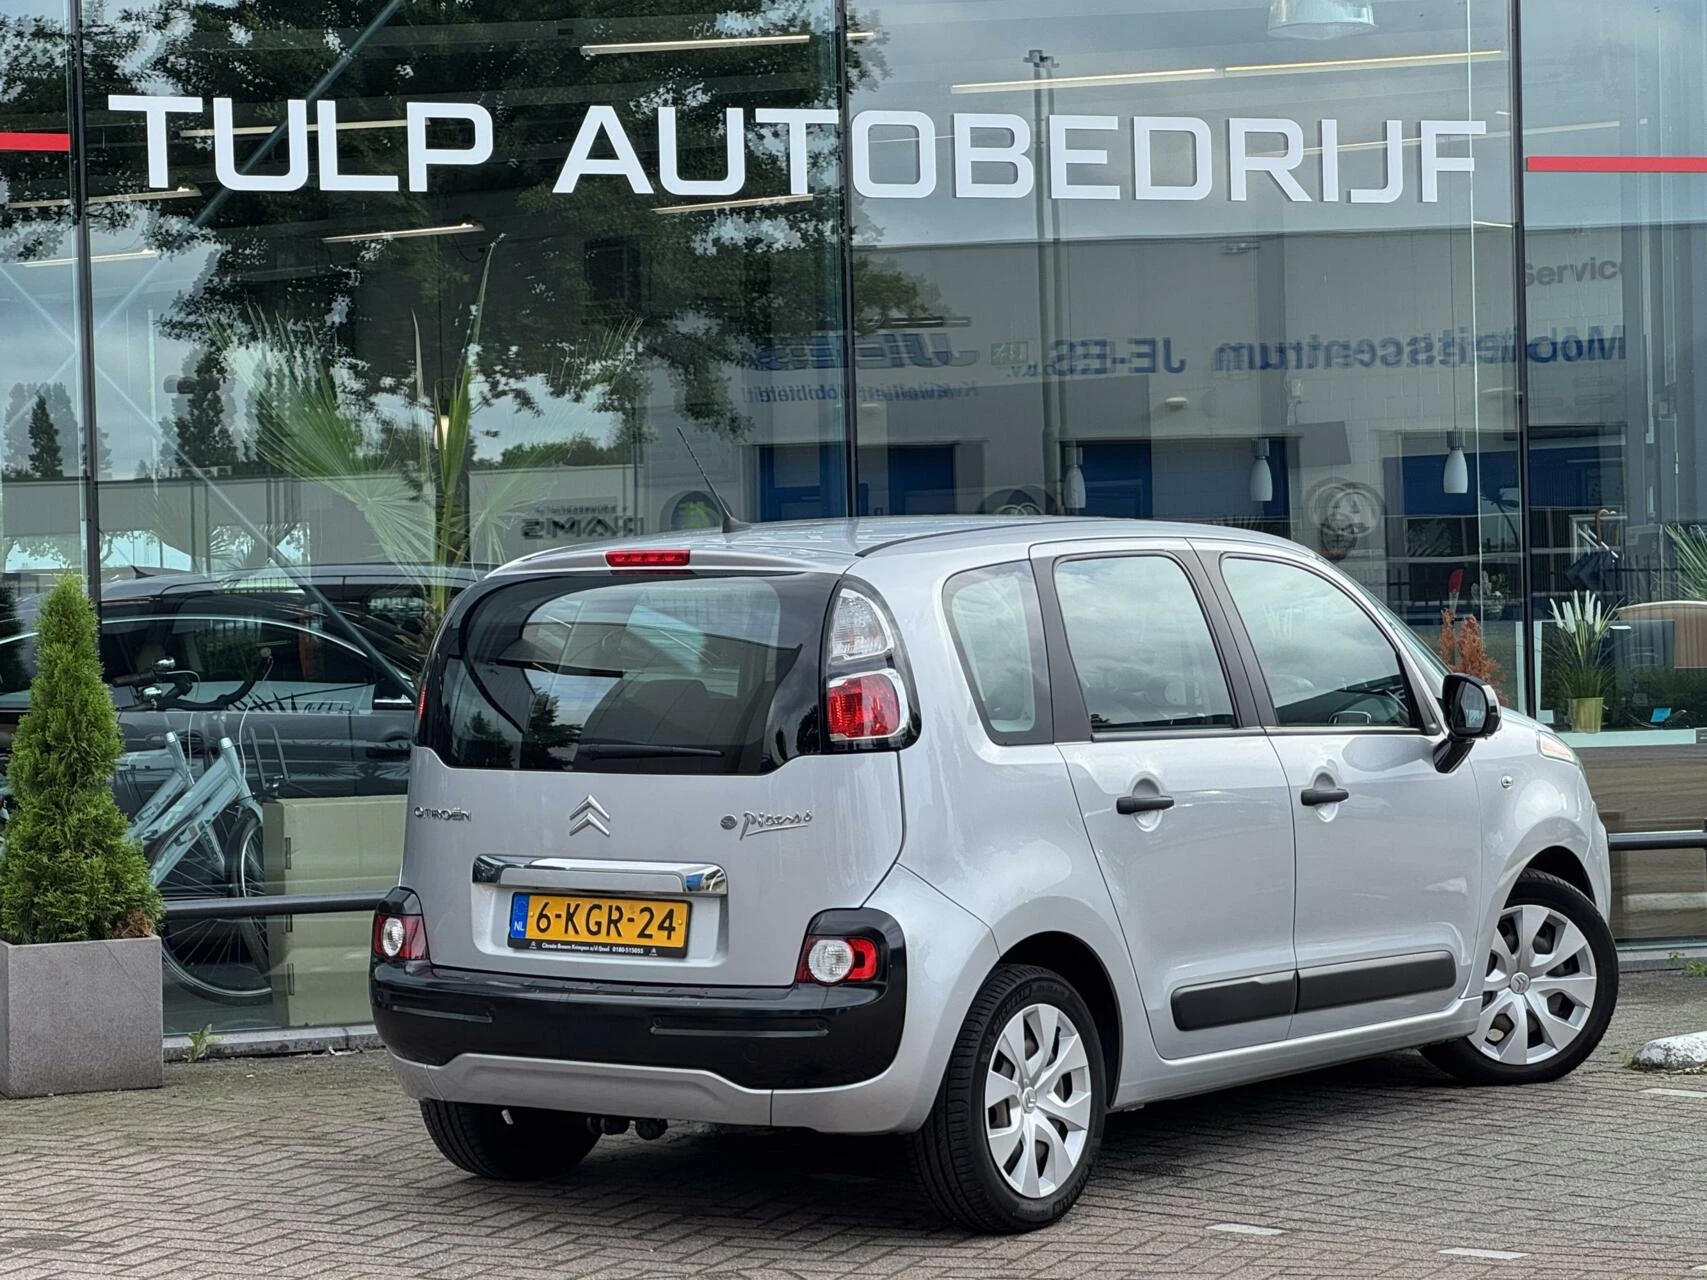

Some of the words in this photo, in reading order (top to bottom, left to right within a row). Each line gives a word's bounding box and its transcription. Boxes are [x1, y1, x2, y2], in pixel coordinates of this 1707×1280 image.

[107, 93, 494, 193] TULP
[551, 104, 1487, 204] AUTOBEDRIJF
[514, 922, 525, 931] NL
[535, 902, 677, 941] 6-KGR-24
